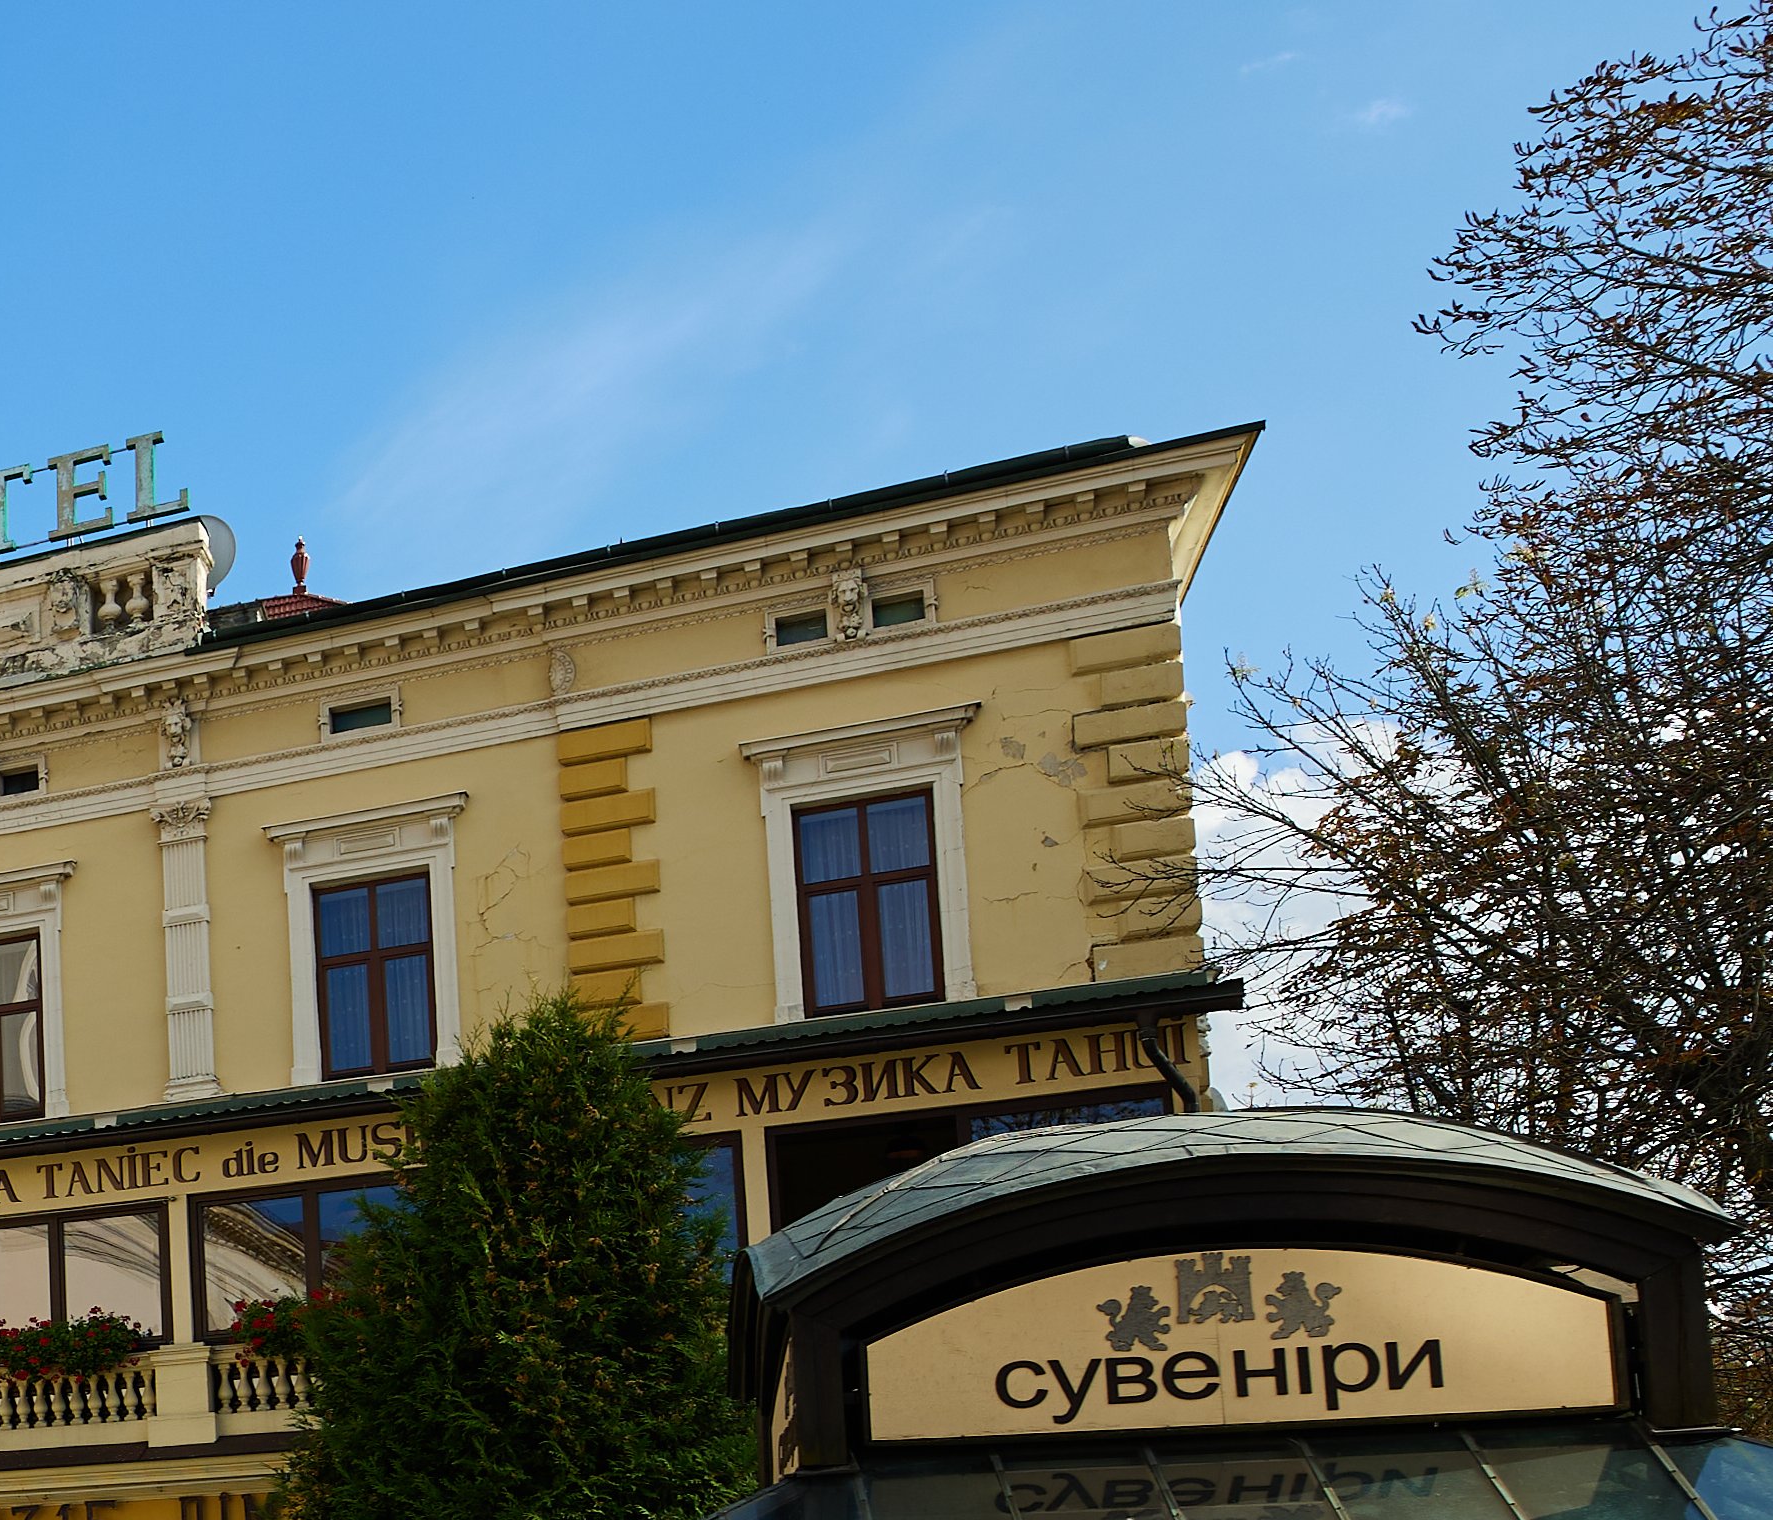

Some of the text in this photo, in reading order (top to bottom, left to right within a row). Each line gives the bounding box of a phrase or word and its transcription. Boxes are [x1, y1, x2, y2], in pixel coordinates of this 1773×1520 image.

[735, 1051, 983, 1117] МУЗИКА
[222, 1140, 280, 1178] die
[994, 1338, 1445, 1425] сувеніри
